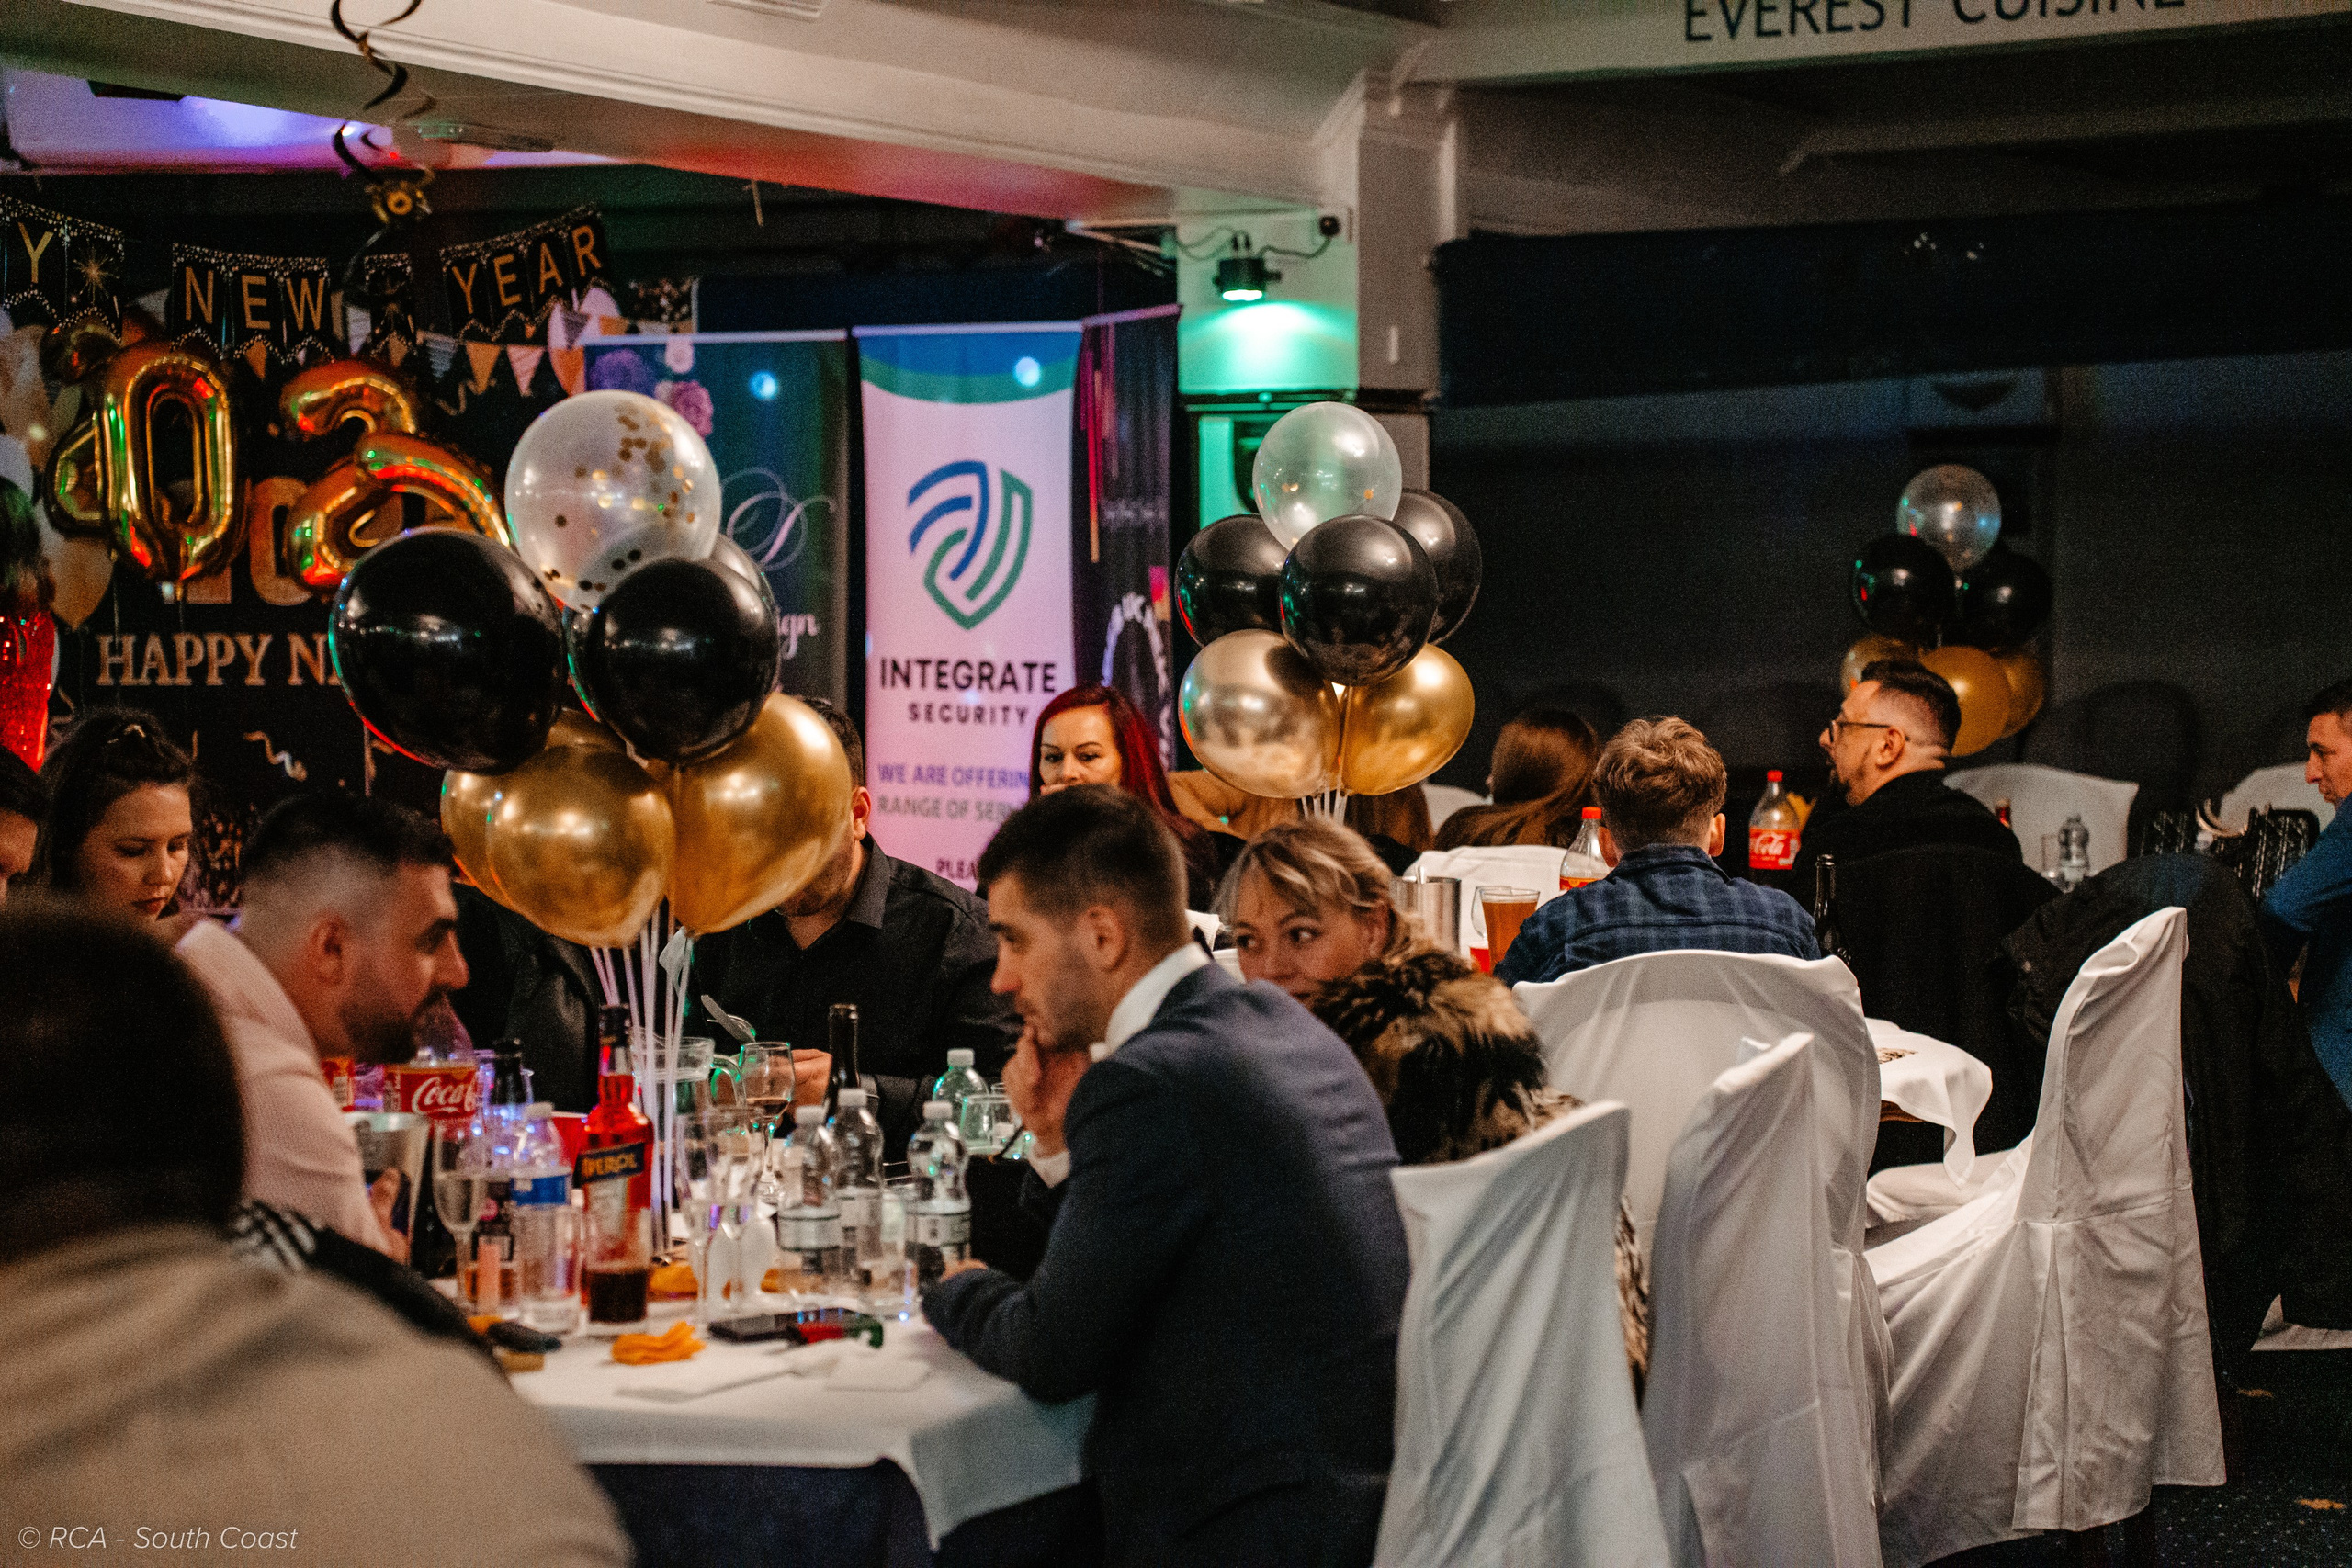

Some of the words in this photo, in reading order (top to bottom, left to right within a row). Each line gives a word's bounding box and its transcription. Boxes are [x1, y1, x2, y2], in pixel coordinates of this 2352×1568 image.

[185, 266, 326, 331] NEW
[451, 224, 603, 315] YEAR
[96, 632, 273, 686] HAPPY
[880, 658, 1057, 693] INTEGRATE
[908, 701, 1029, 725] SECURITY
[877, 763, 906, 784] WE
[912, 764, 947, 786] ARE
[950, 766, 1030, 789] OFFERIN
[876, 795, 942, 819] RANGE
[945, 798, 969, 820] OF
[935, 858, 978, 882] PLEA
